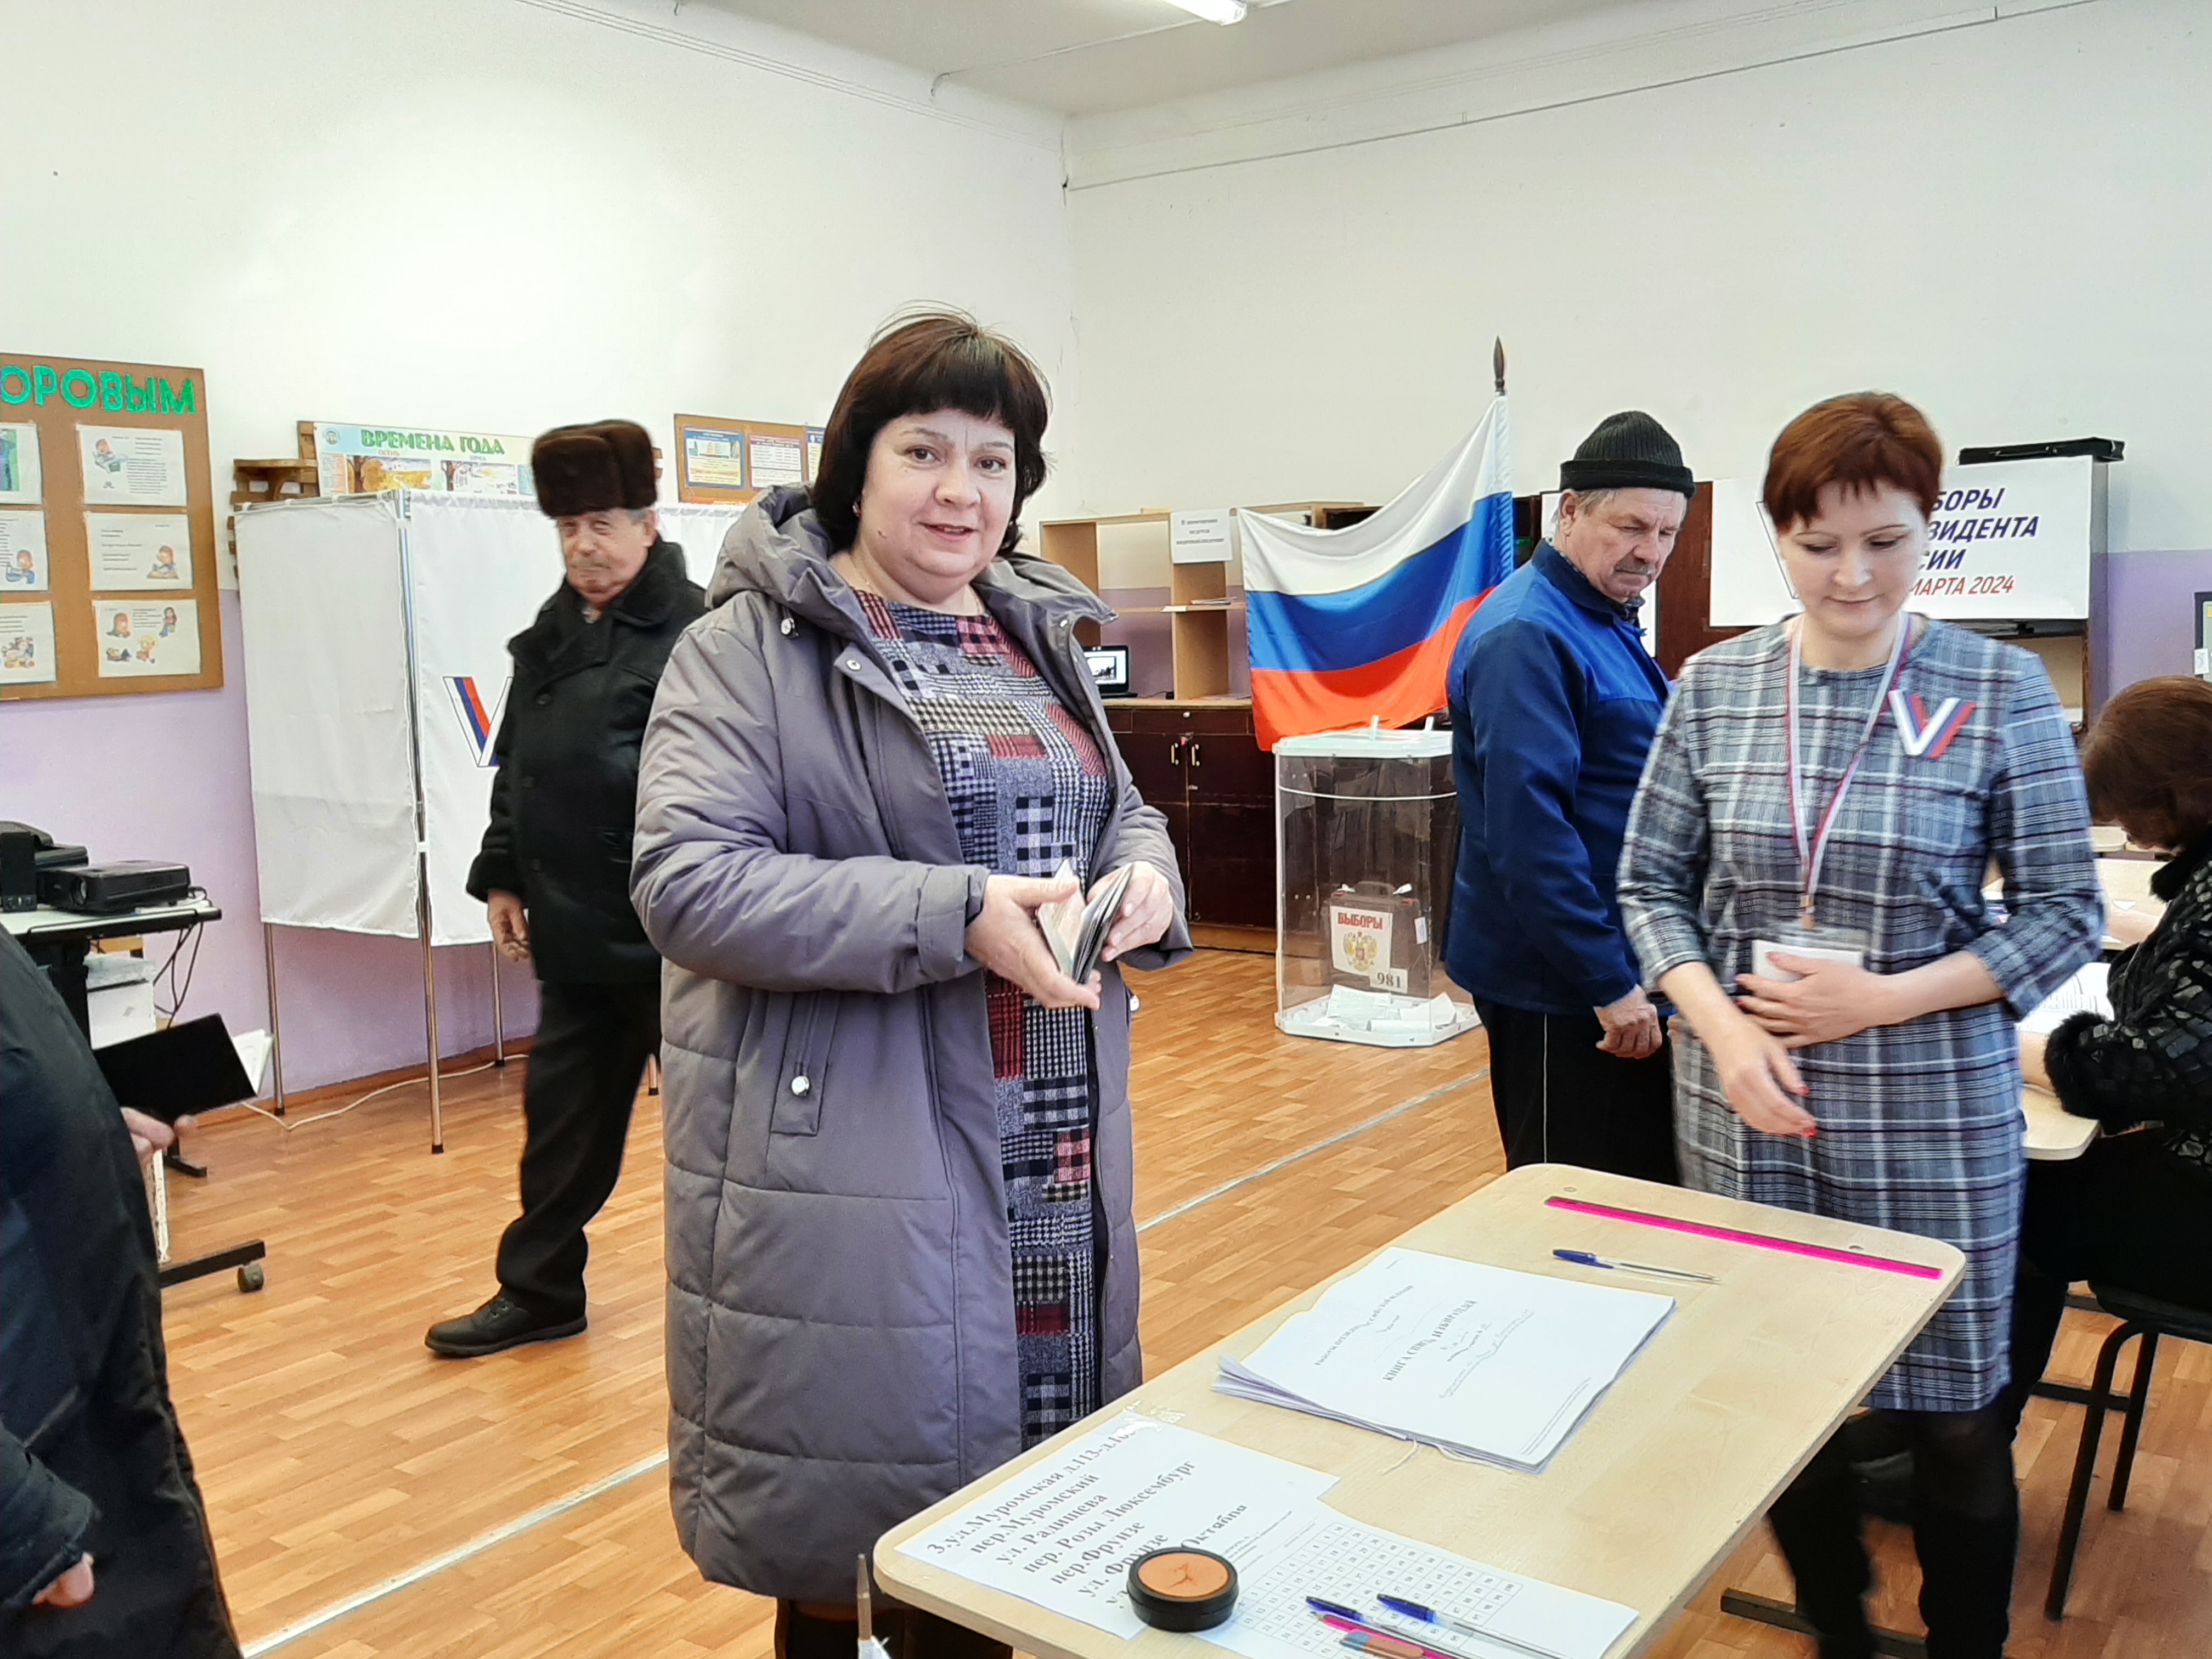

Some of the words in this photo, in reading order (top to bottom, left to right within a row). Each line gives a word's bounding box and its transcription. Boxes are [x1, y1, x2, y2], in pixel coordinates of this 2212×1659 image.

[0, 364, 196, 415] ОРОВЫМ
[361, 430, 455, 452] ВРЕМЕНА
[460, 436, 505, 455] ГОДА
[1968, 575, 2014, 595] 2024
[1338, 912, 1383, 930] ВЫБОРЫ
[1377, 972, 1401, 988] 981
[970, 1473, 1099, 1554] пер.Муромский
[995, 1545, 1028, 1565] ул.
[1022, 1494, 1109, 1545] Радищева
[1023, 1550, 1063, 1573] пер.
[1058, 1521, 1108, 1549] Розы
[1102, 1459, 1197, 1522] Люксембург
[1050, 1521, 1146, 1585] пер.Фрунзе
